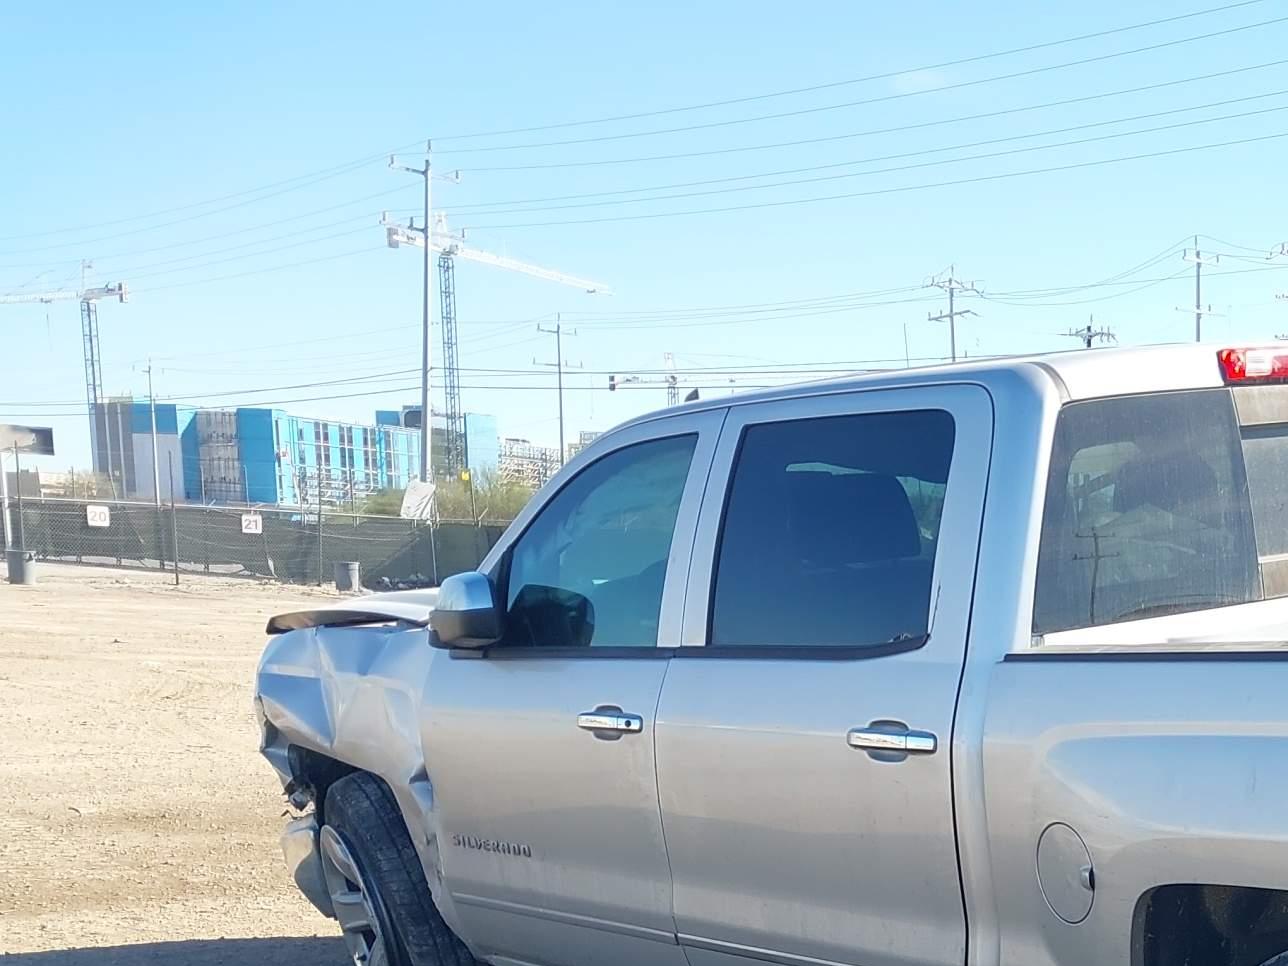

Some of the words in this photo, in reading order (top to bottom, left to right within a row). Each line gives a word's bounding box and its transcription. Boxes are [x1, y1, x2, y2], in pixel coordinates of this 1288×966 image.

[89, 511, 108, 523] 20
[244, 518, 258, 530] 21
[452, 834, 532, 858] SILVERADO
